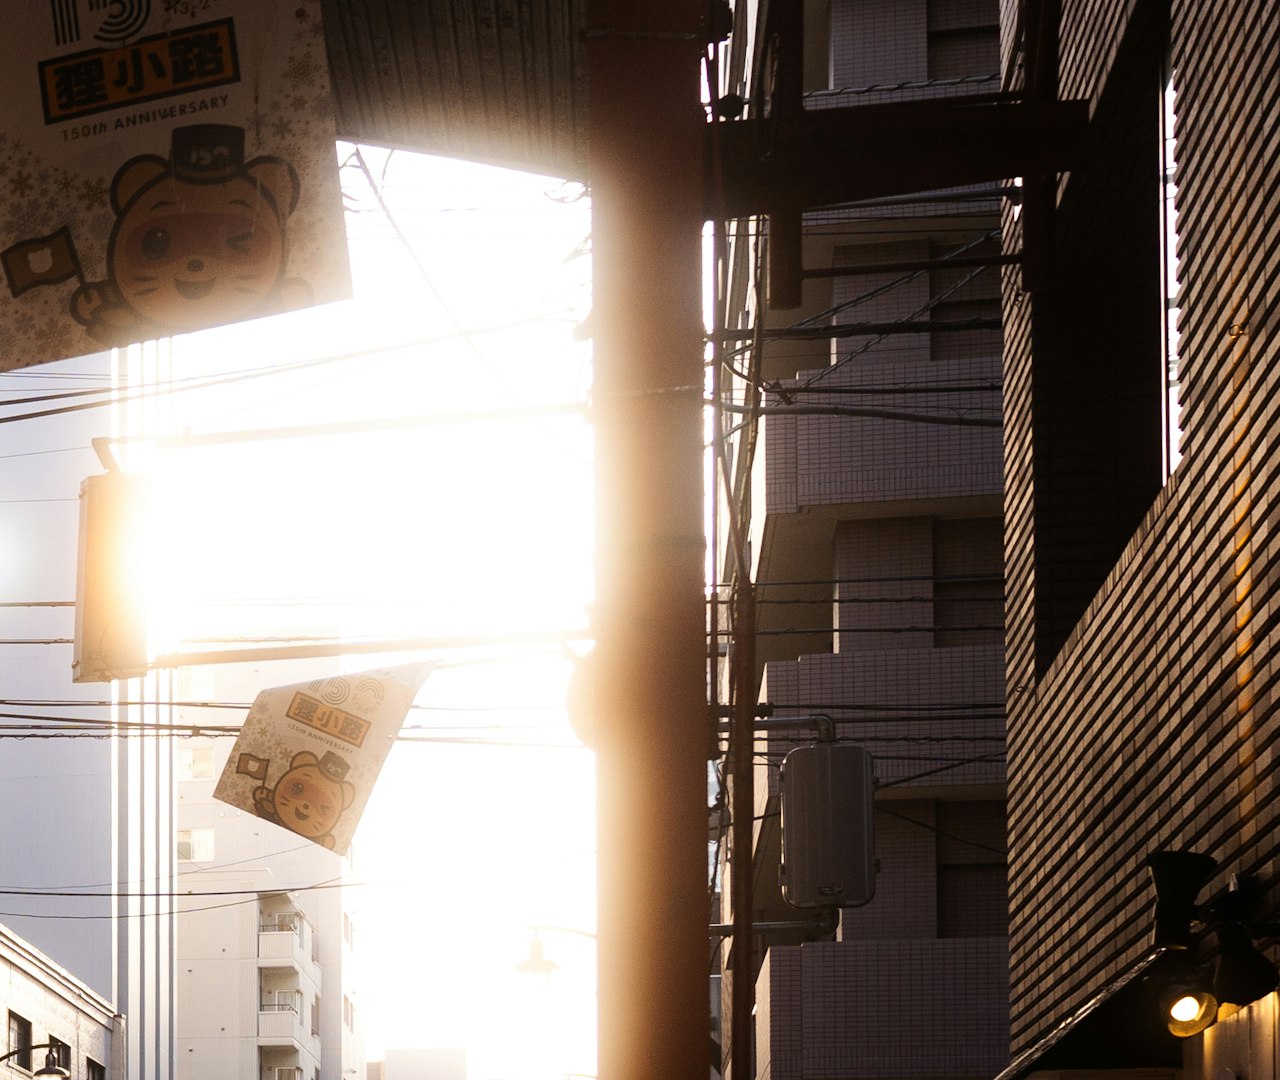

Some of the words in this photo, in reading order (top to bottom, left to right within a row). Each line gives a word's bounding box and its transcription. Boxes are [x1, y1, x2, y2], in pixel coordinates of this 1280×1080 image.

[54, 34, 224, 110] 狸小路
[61, 123, 108, 142] 150th
[114, 94, 229, 131] ANNIVERSARY
[308, 731, 354, 754] ANNIVERSARY
